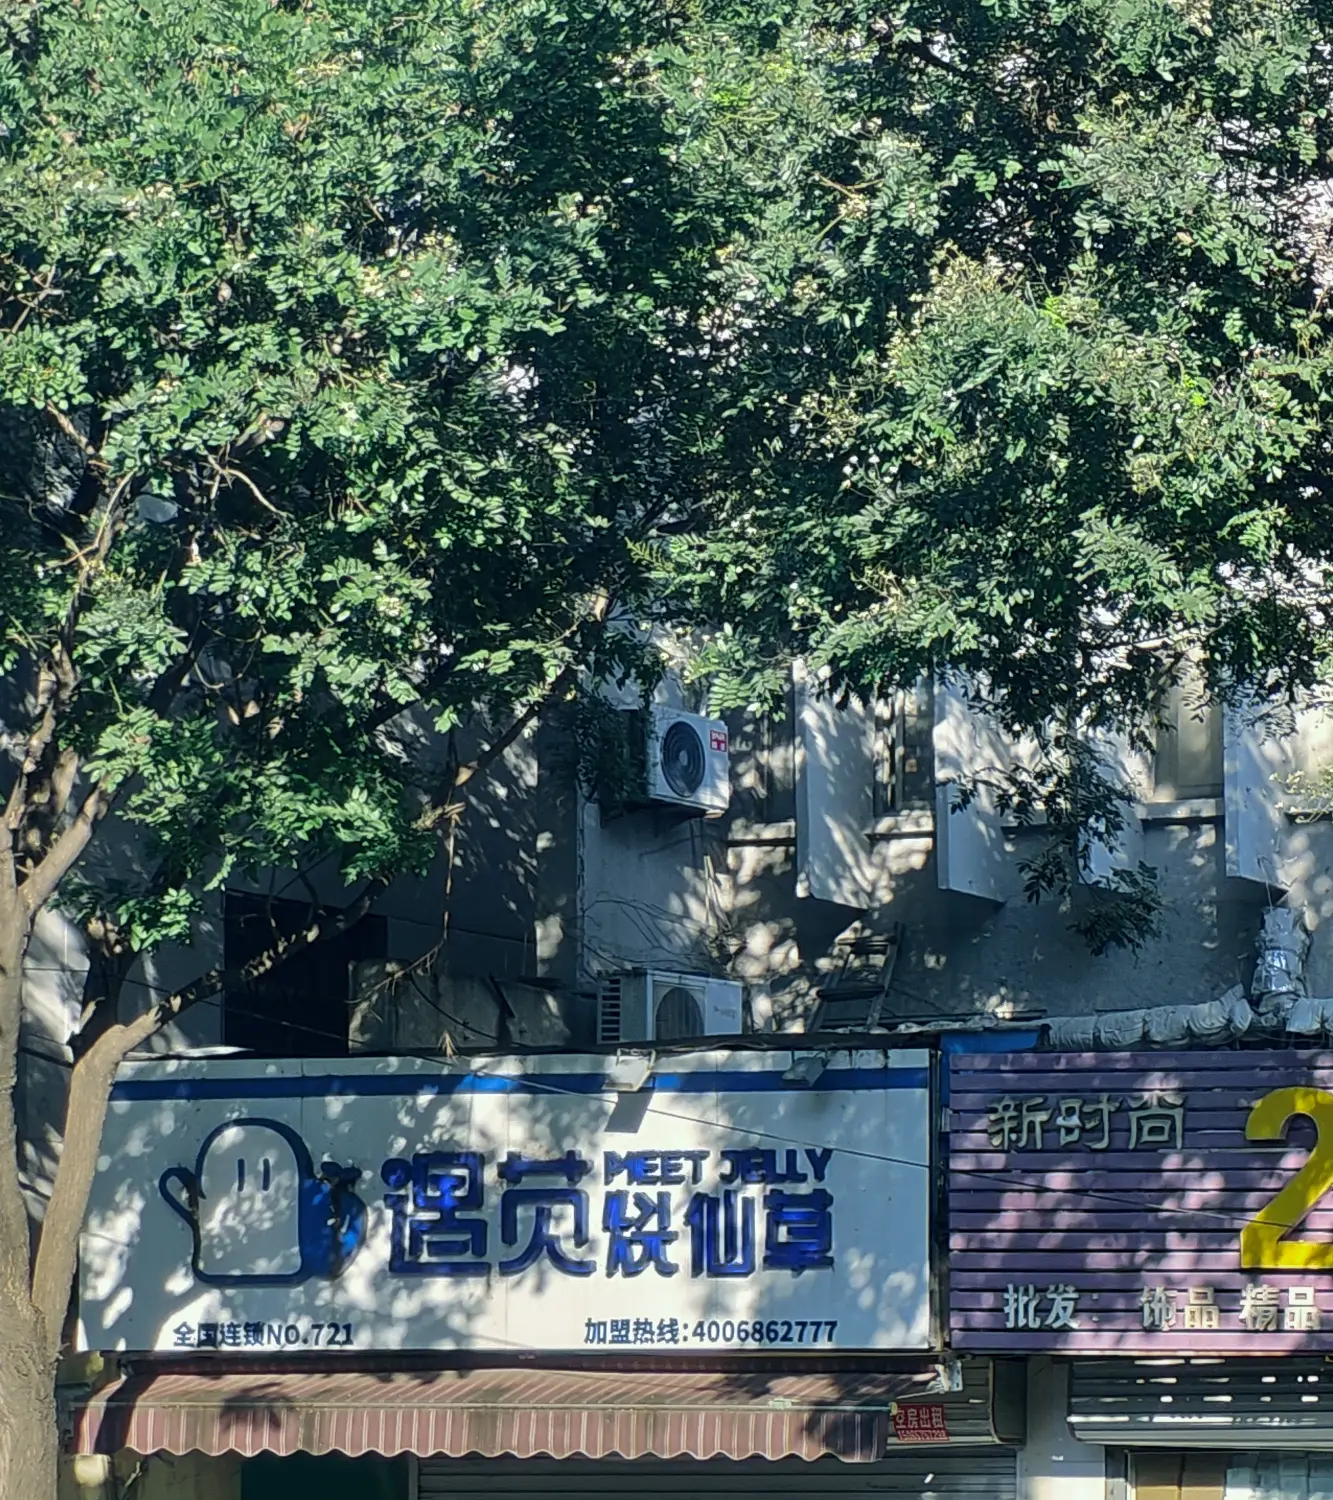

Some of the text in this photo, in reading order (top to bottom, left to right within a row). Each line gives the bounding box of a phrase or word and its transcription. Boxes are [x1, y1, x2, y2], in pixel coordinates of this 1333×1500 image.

[987, 1091, 1186, 1153] 新时尚
[602, 1147, 835, 1185] MEET JELLY
[1140, 1284, 1220, 1333] 饰品
[1240, 1282, 1321, 1331] 精品
[173, 1320, 354, 1348] 全国连锁NO.721
